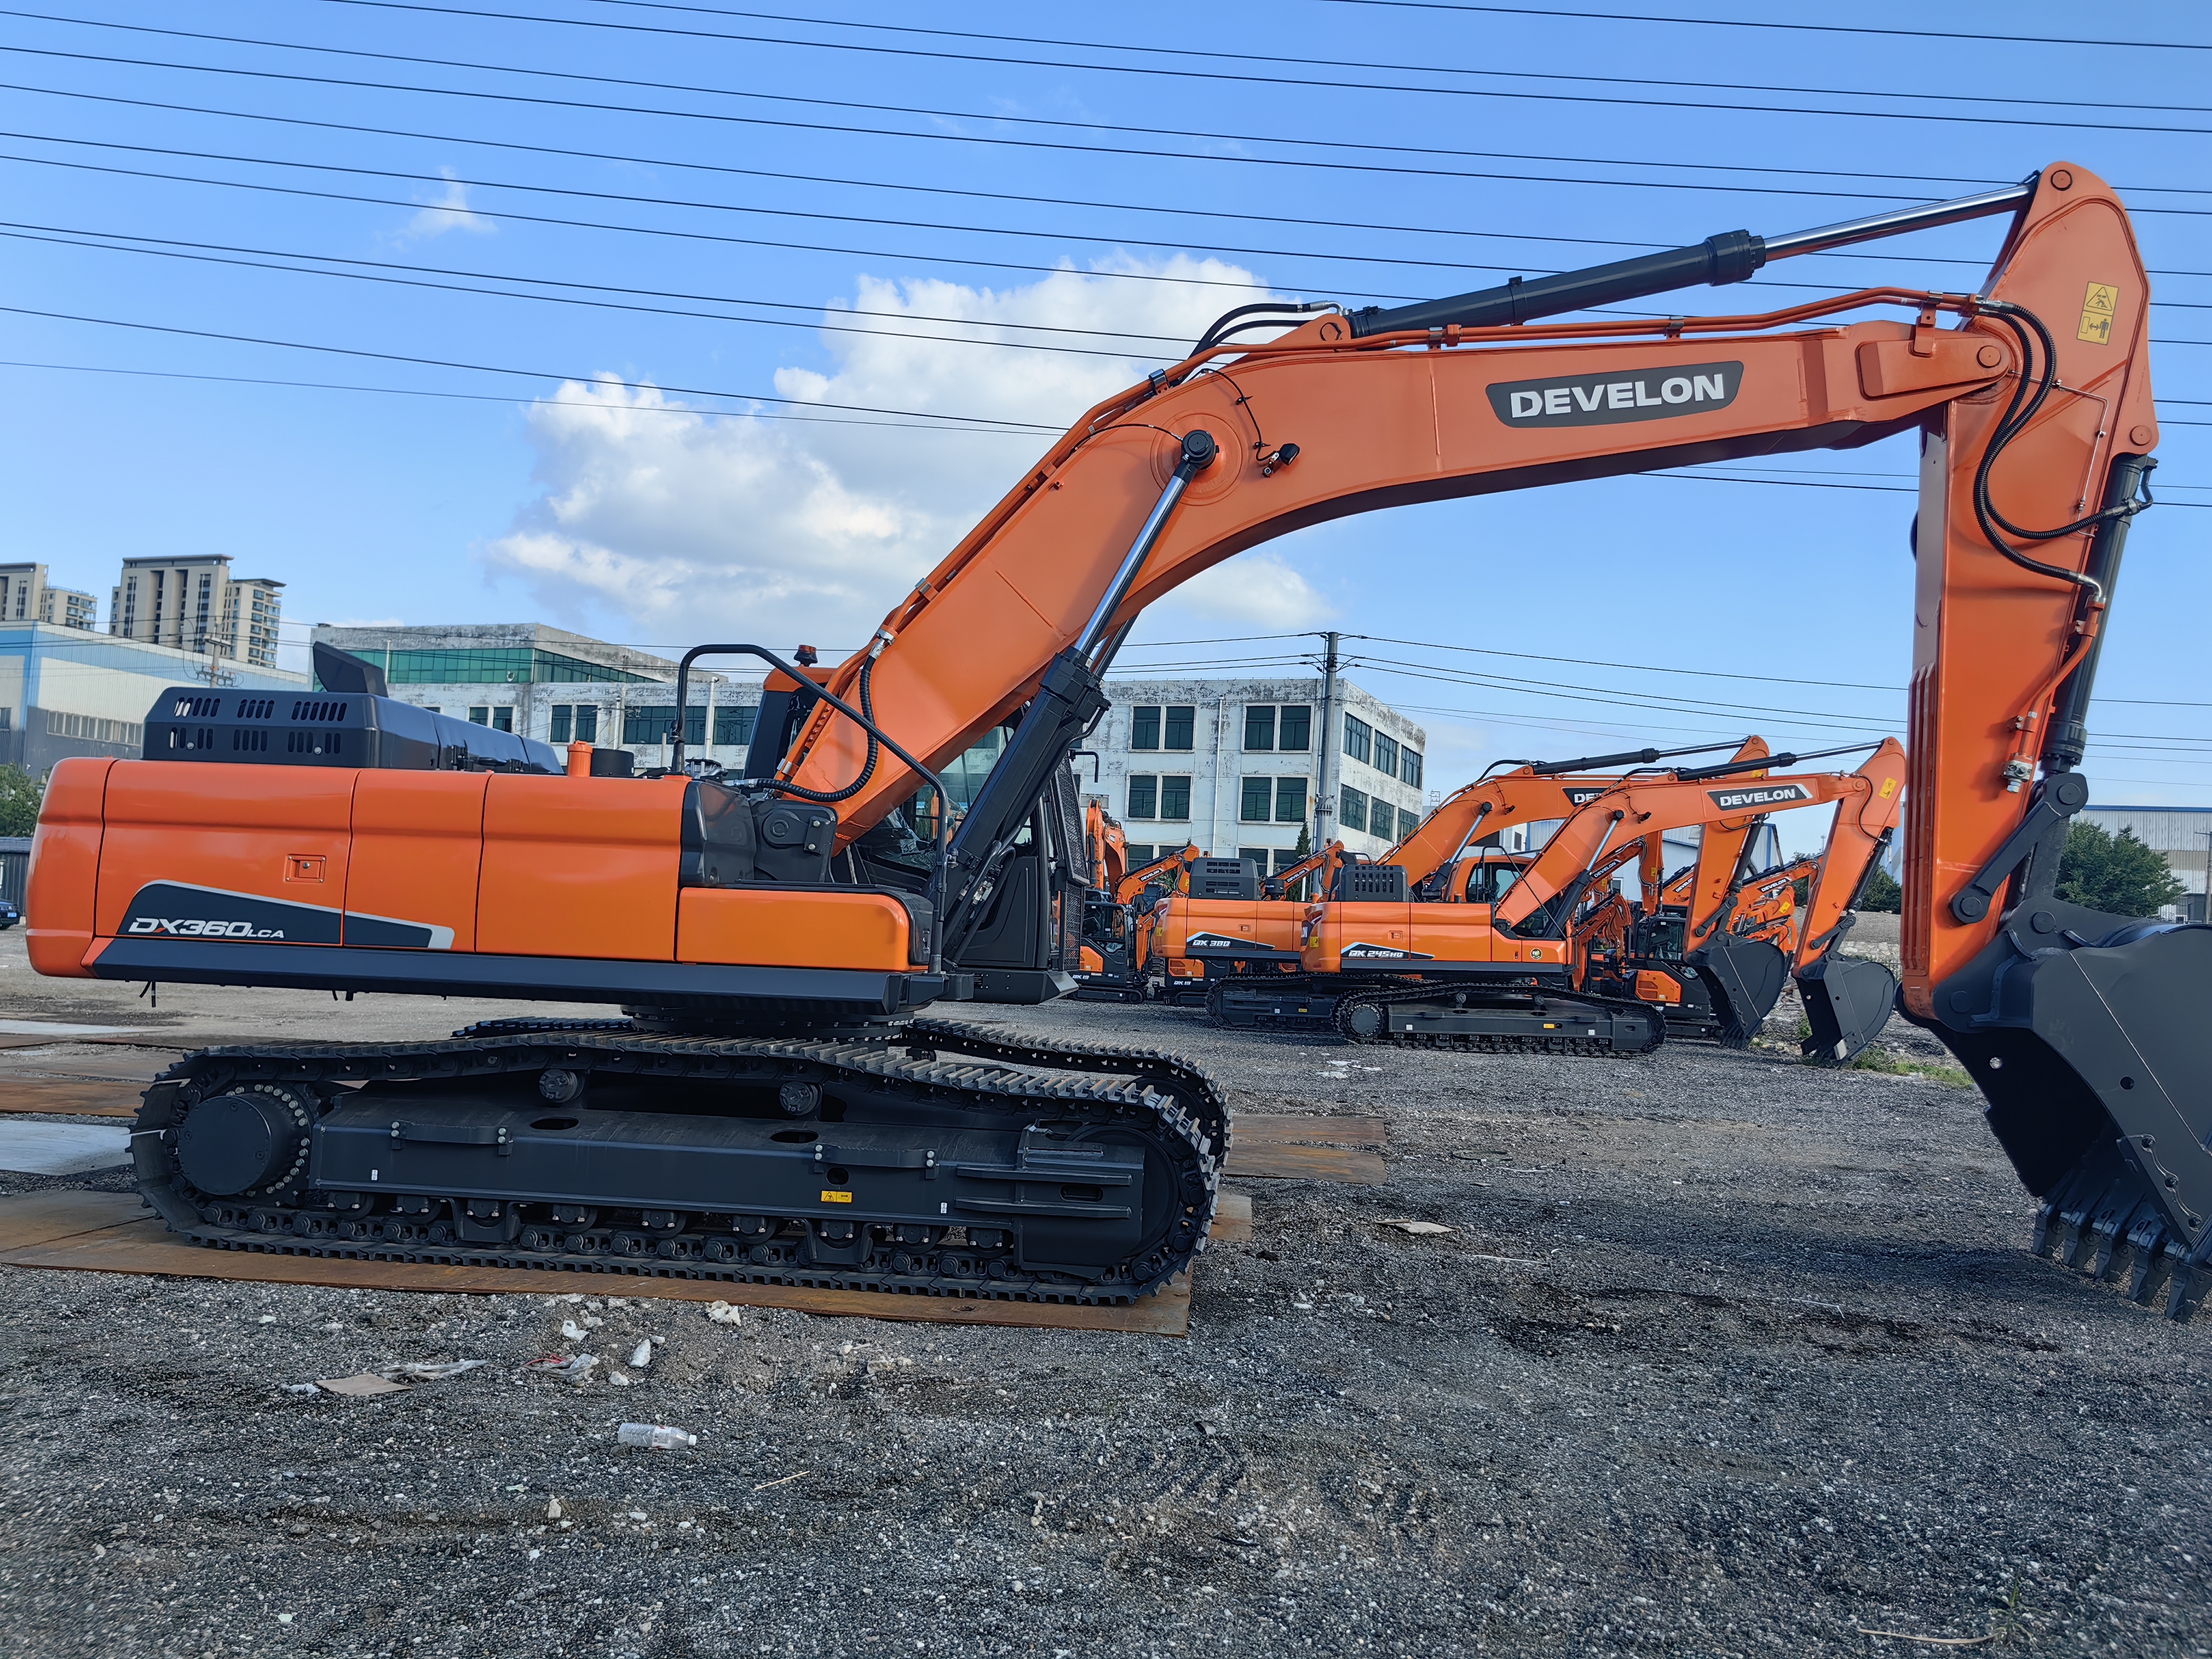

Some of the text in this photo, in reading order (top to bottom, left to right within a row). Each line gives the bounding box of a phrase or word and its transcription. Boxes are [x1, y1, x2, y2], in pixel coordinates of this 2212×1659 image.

[1510, 373, 1724, 418] DEVELON
[1719, 788, 1796, 806] DEVELON
[1141, 869, 1159, 881] DEVELON
[1287, 869, 1305, 882] DEVELON
[1594, 861, 1616, 878] DEVELON
[1761, 879, 1786, 892] DEVELON
